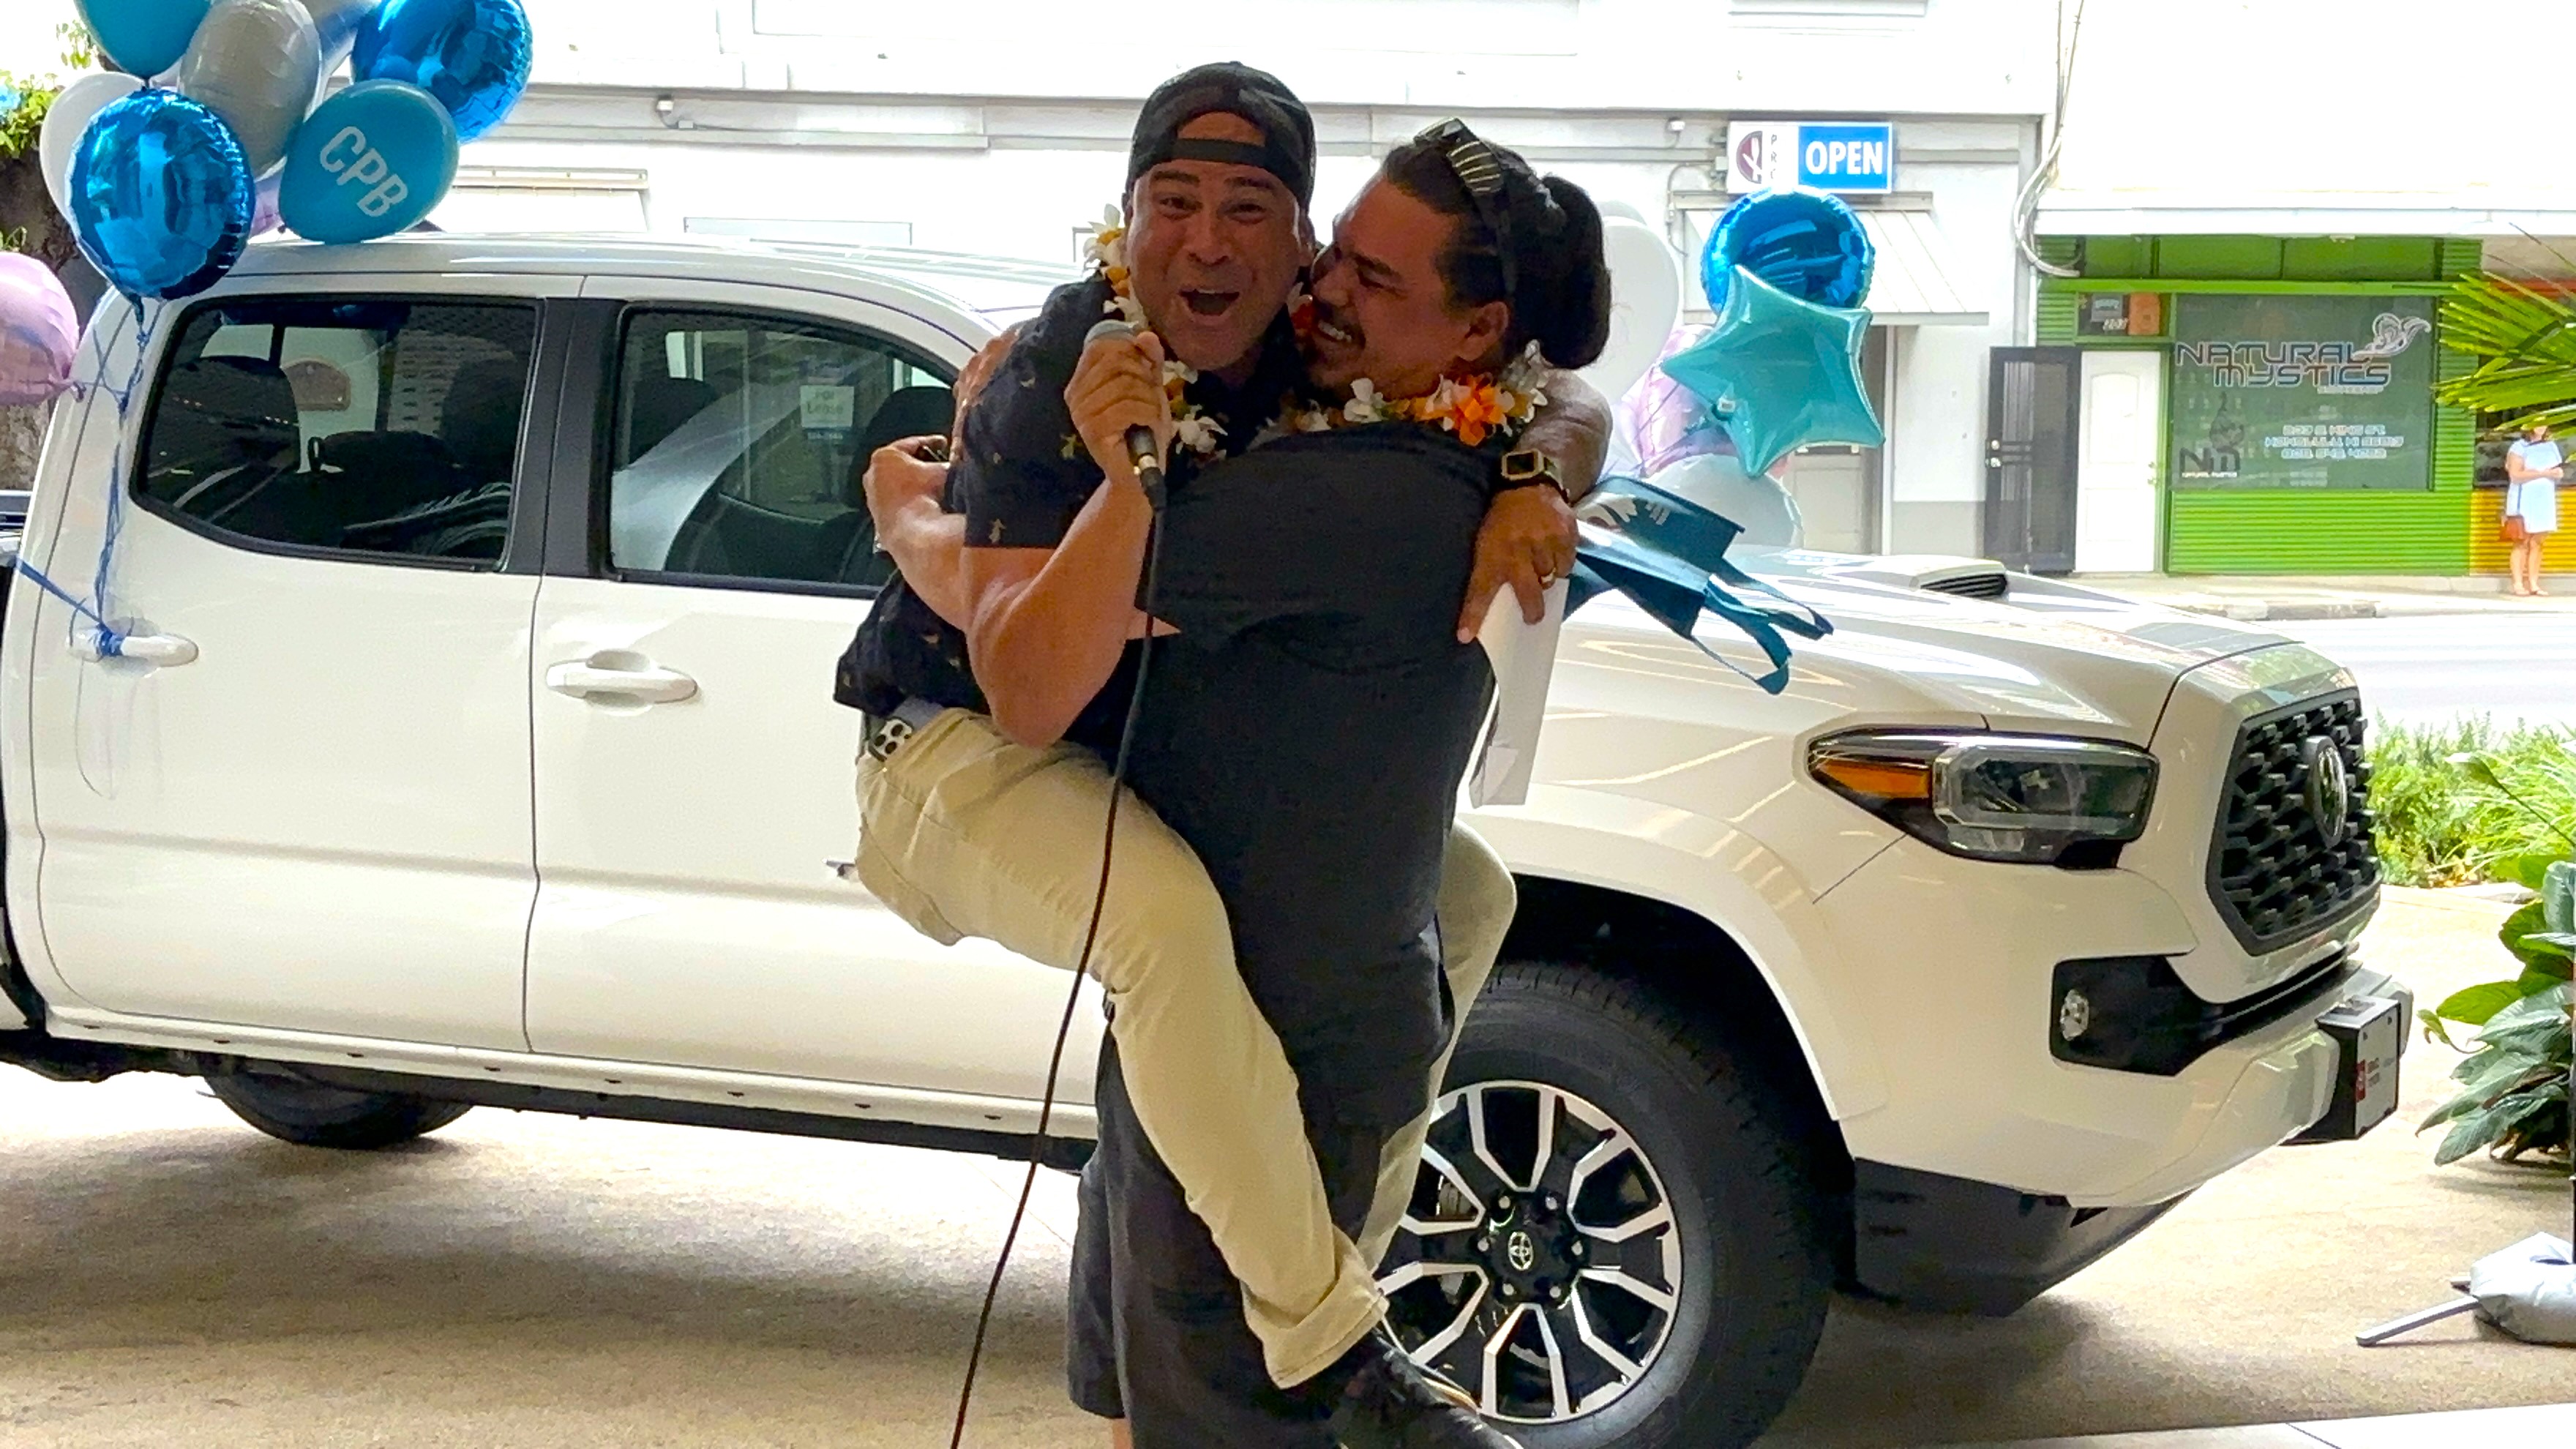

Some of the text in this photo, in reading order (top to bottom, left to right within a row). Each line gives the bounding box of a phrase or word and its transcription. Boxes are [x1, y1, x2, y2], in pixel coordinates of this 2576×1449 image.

[320, 126, 408, 217] CPB
[1805, 141, 1883, 175] OPEN
[2176, 342, 2370, 366] NATURAL
[2214, 363, 2391, 387] MYSTICS
